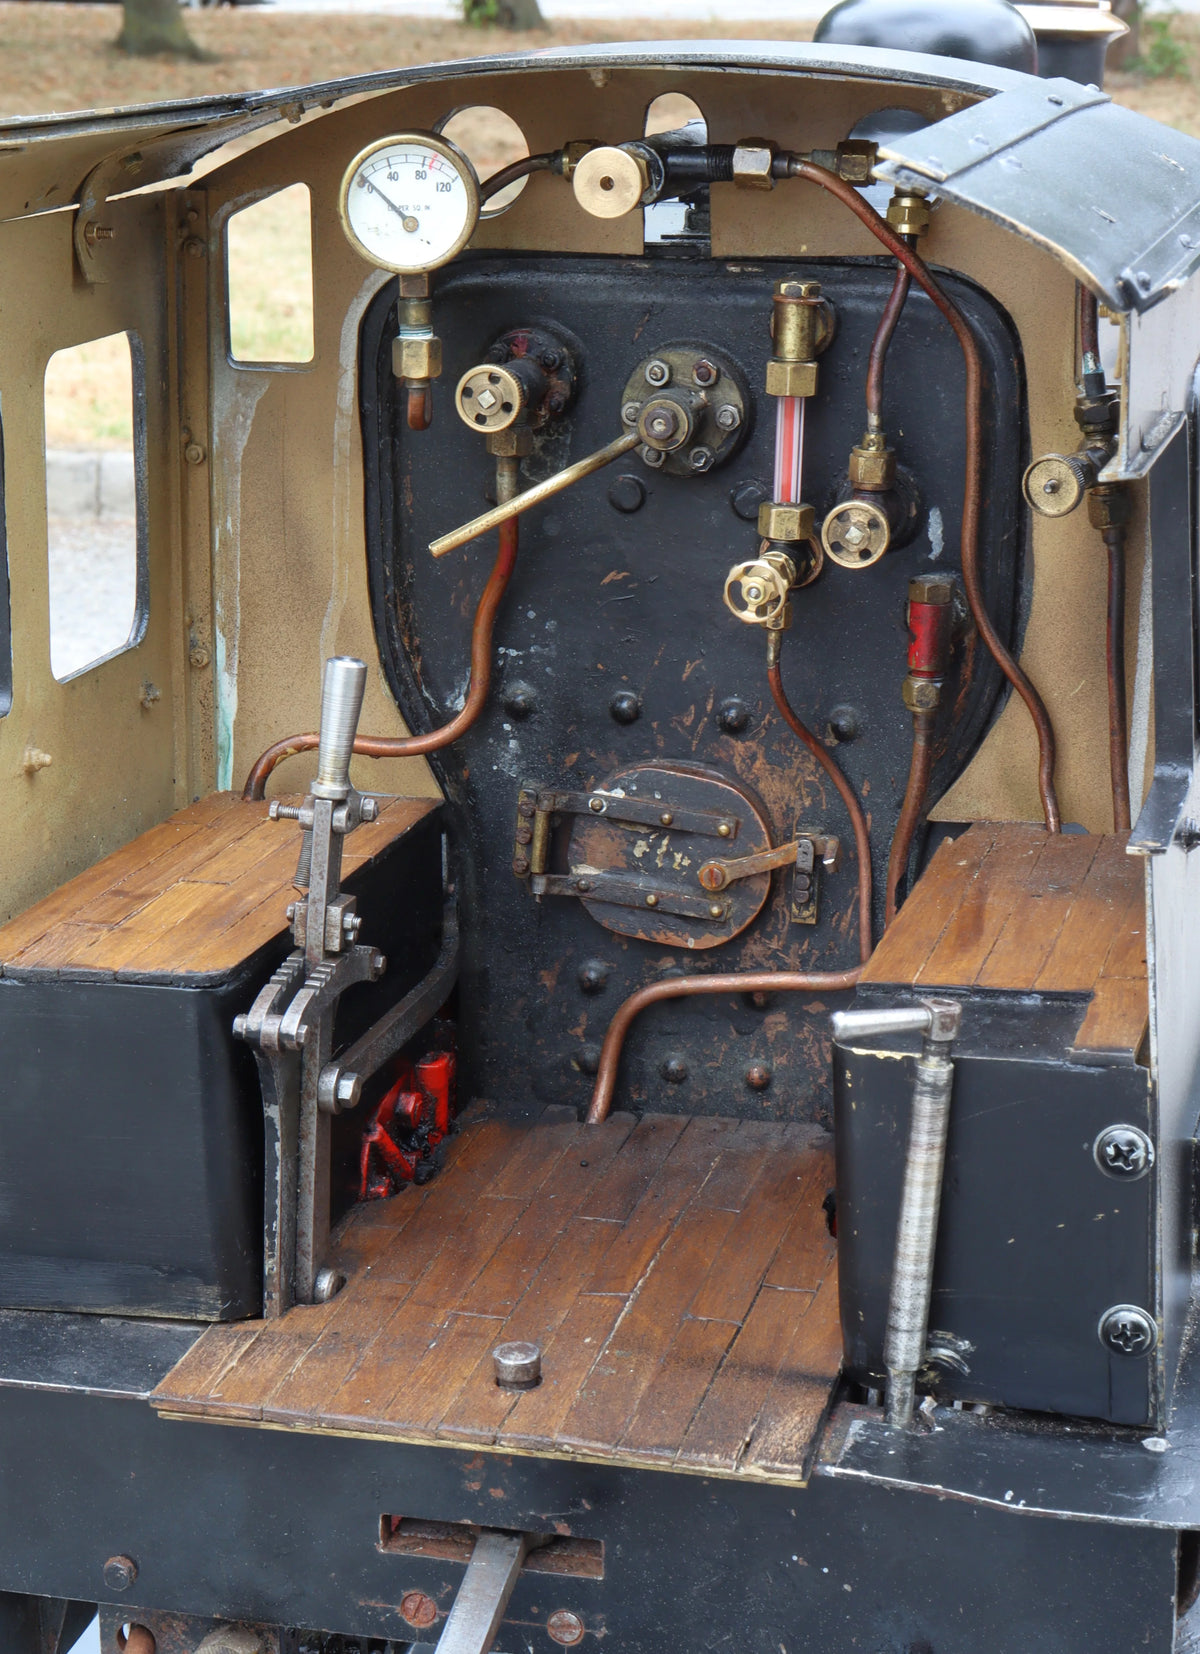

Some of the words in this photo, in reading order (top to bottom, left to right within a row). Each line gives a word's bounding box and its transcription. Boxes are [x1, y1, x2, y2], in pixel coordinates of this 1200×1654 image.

[387, 171, 399, 182] 40
[415, 170, 427, 181] 80
[367, 184, 374, 194] 0
[436, 182, 452, 193] 120
